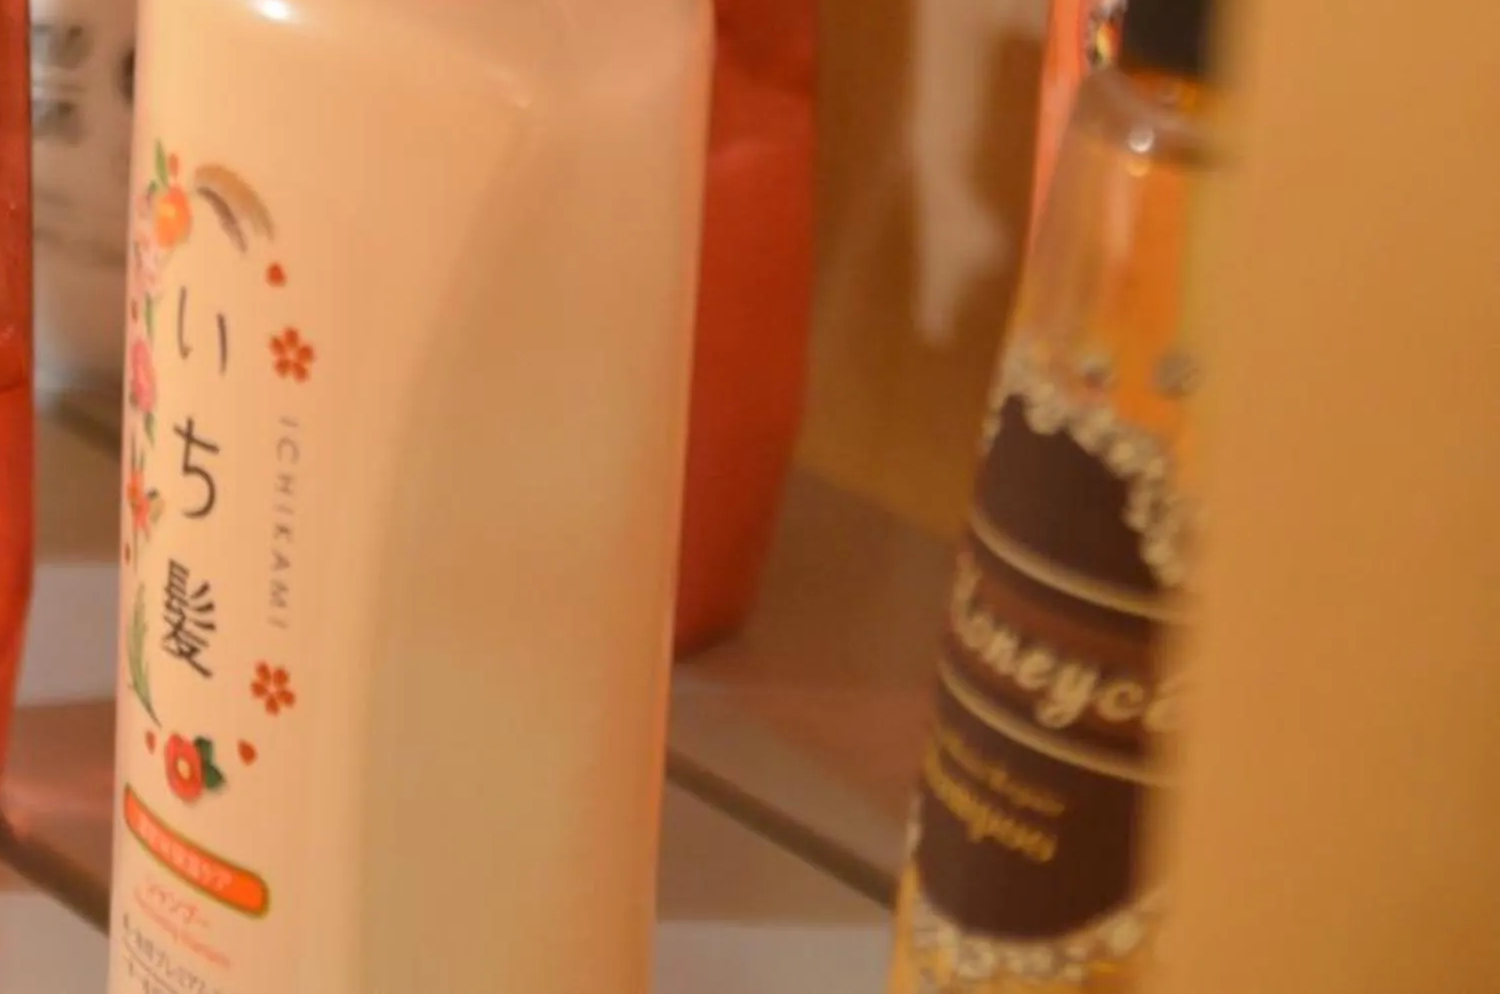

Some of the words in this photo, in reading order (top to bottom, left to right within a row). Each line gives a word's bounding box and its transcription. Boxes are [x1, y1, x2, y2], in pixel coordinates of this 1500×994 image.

[160, 286, 229, 679] いち髪
[267, 415, 301, 630] ICHIKAMI
